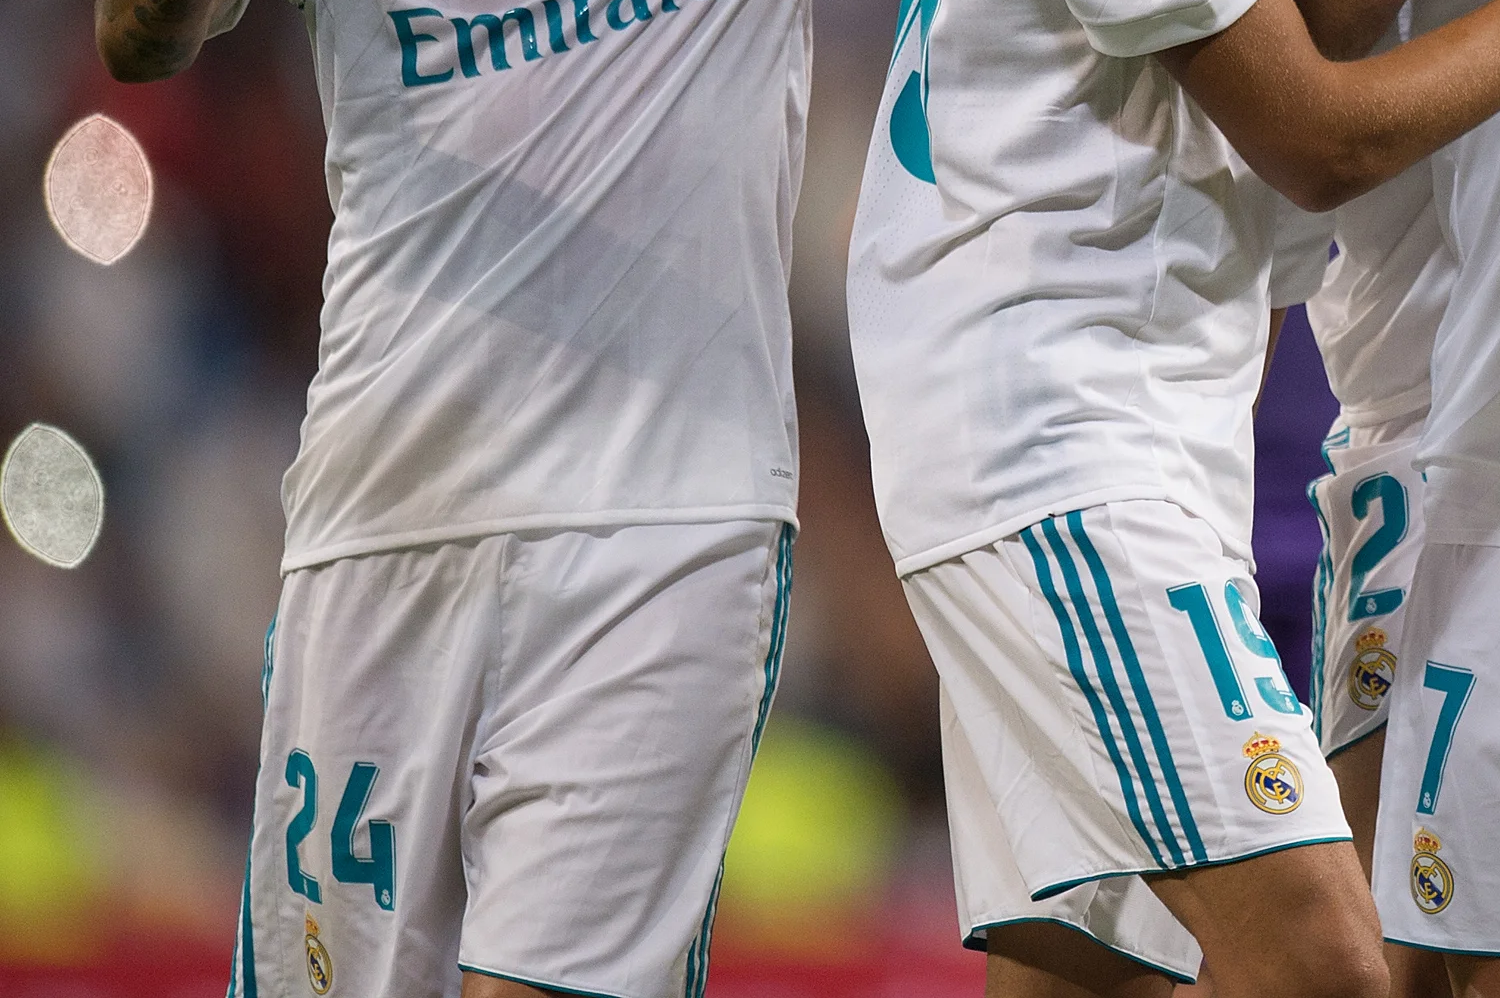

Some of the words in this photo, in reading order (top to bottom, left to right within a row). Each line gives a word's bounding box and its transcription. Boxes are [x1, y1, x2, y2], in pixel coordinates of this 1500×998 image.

[1166, 578, 1304, 721] 19
[1416, 660, 1477, 814] 7
[284, 747, 396, 912] 24
